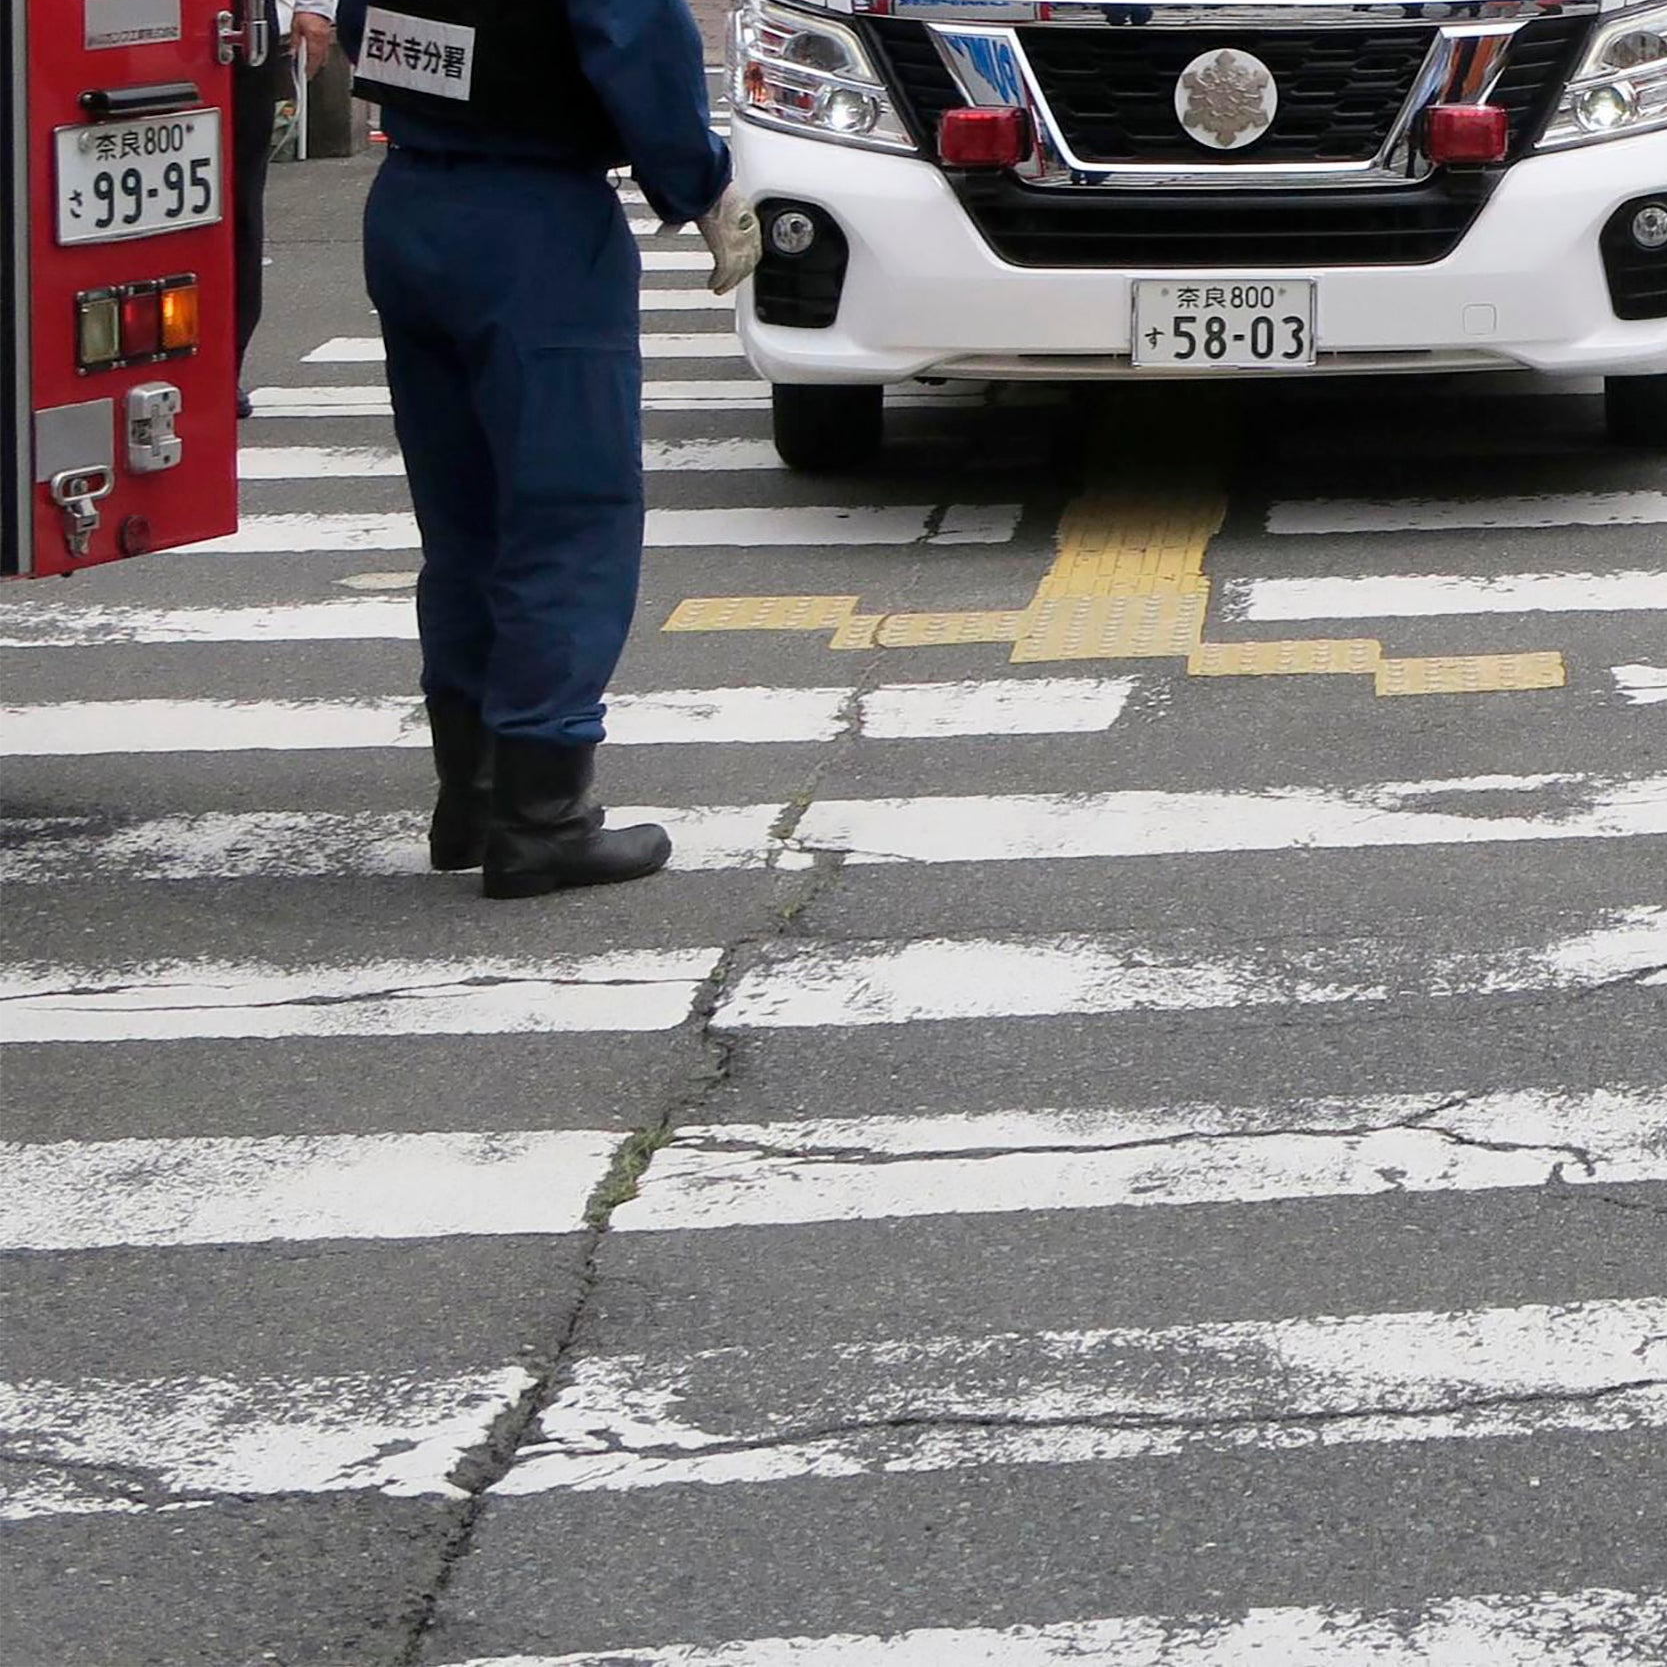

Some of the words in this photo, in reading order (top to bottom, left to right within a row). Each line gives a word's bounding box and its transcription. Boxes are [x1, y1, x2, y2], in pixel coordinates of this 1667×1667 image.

[365, 29, 466, 80] 西大寺分署
[68, 189, 83, 219] さ
[93, 157, 212, 229] 99-95
[1144, 327, 1165, 350] す
[1173, 315, 1305, 360] 58-03
